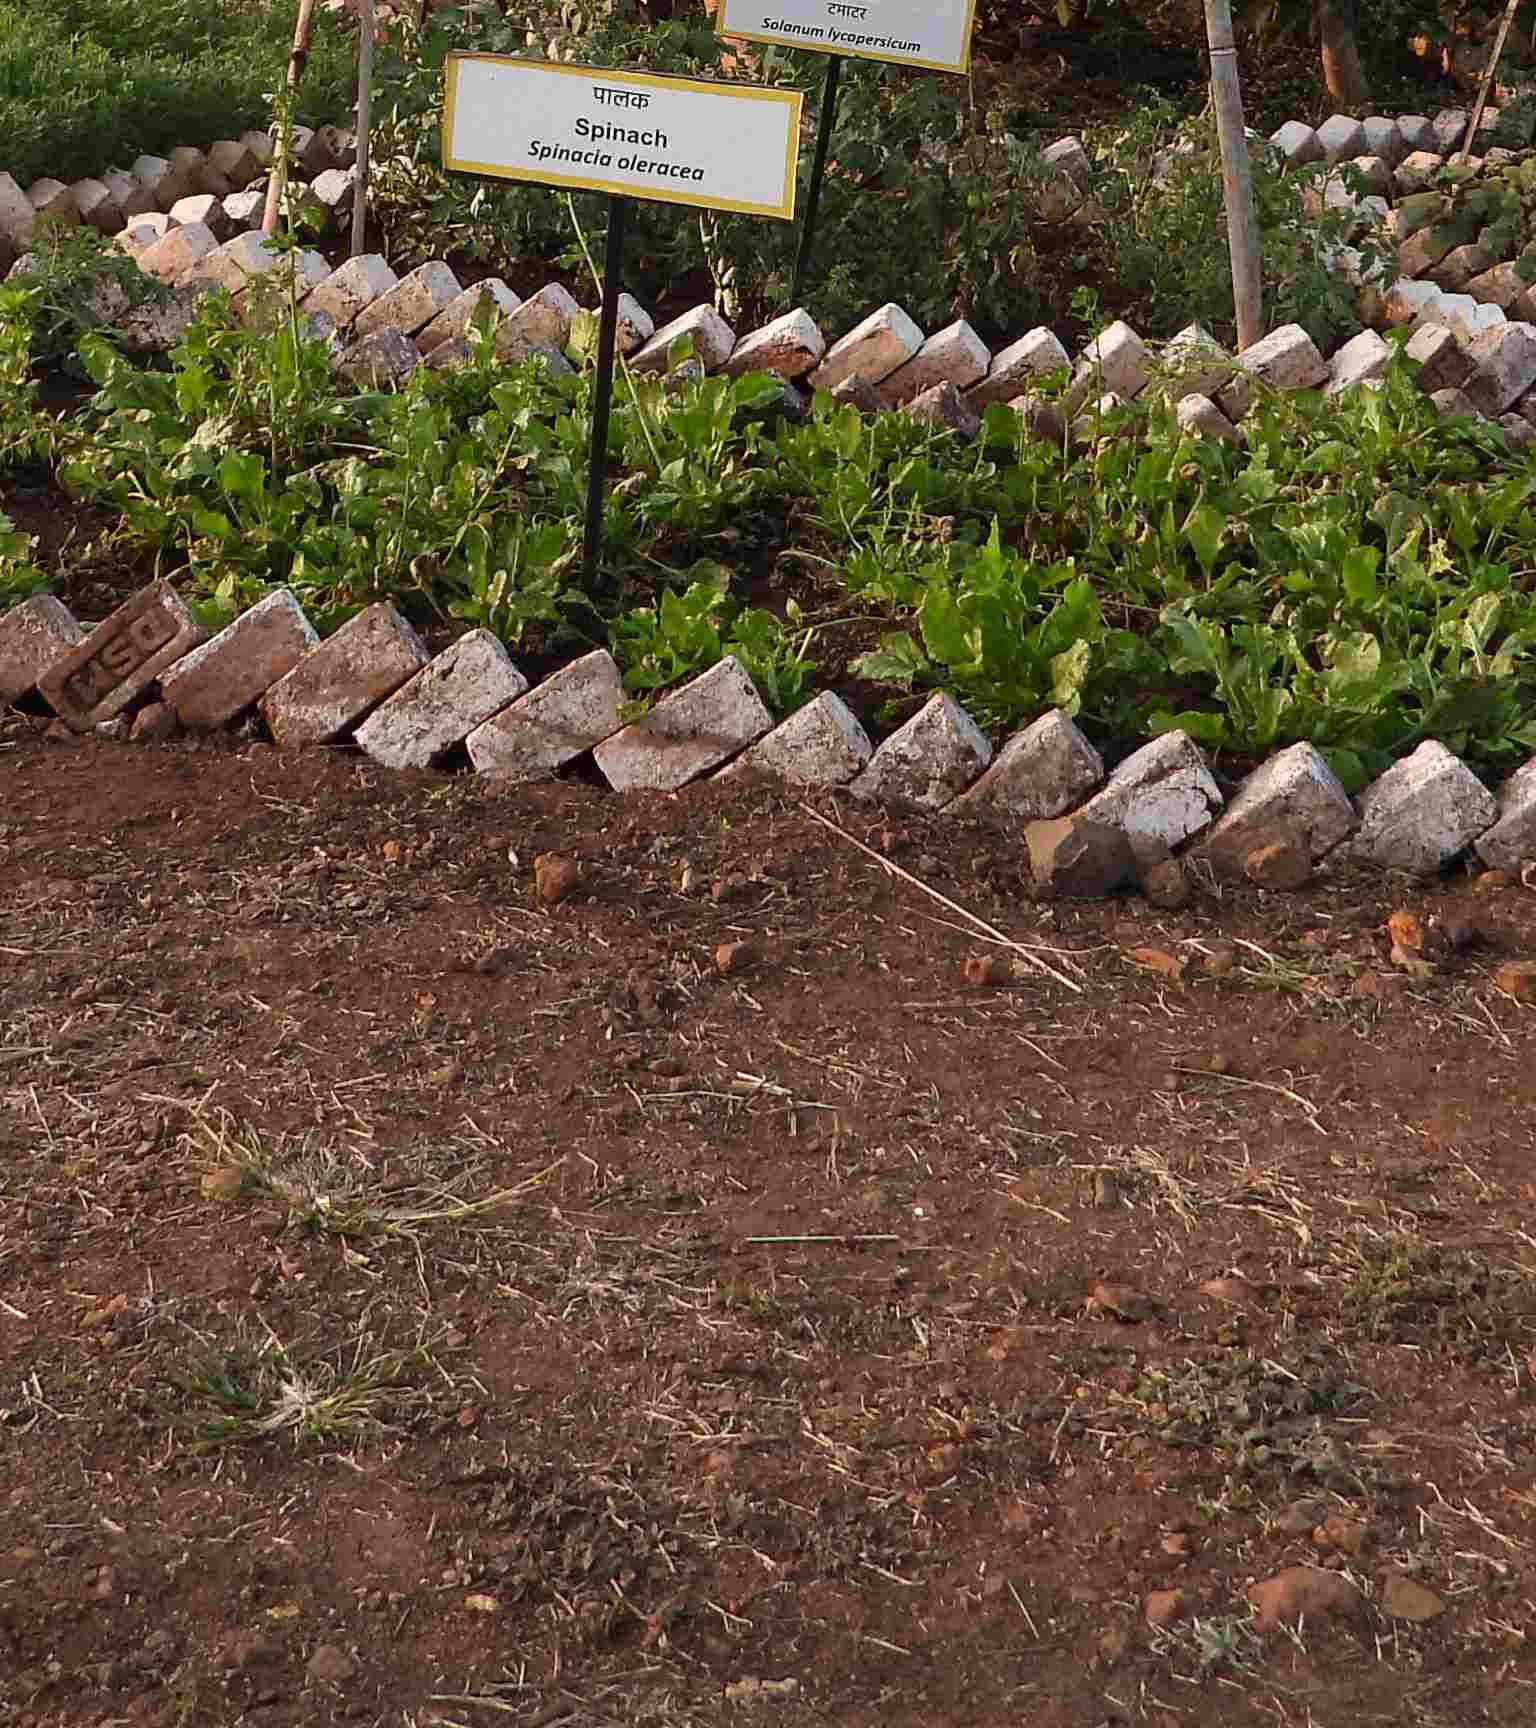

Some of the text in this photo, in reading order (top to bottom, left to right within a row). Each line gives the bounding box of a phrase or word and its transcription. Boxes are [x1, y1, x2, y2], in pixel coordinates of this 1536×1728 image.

[827, 2, 868, 20] टमाटर
[761, 17, 921, 53] Solanum lycopersicum
[592, 86, 651, 110] पालक
[574, 117, 668, 149] Spinach
[527, 140, 705, 181] Spinacia oleracea
